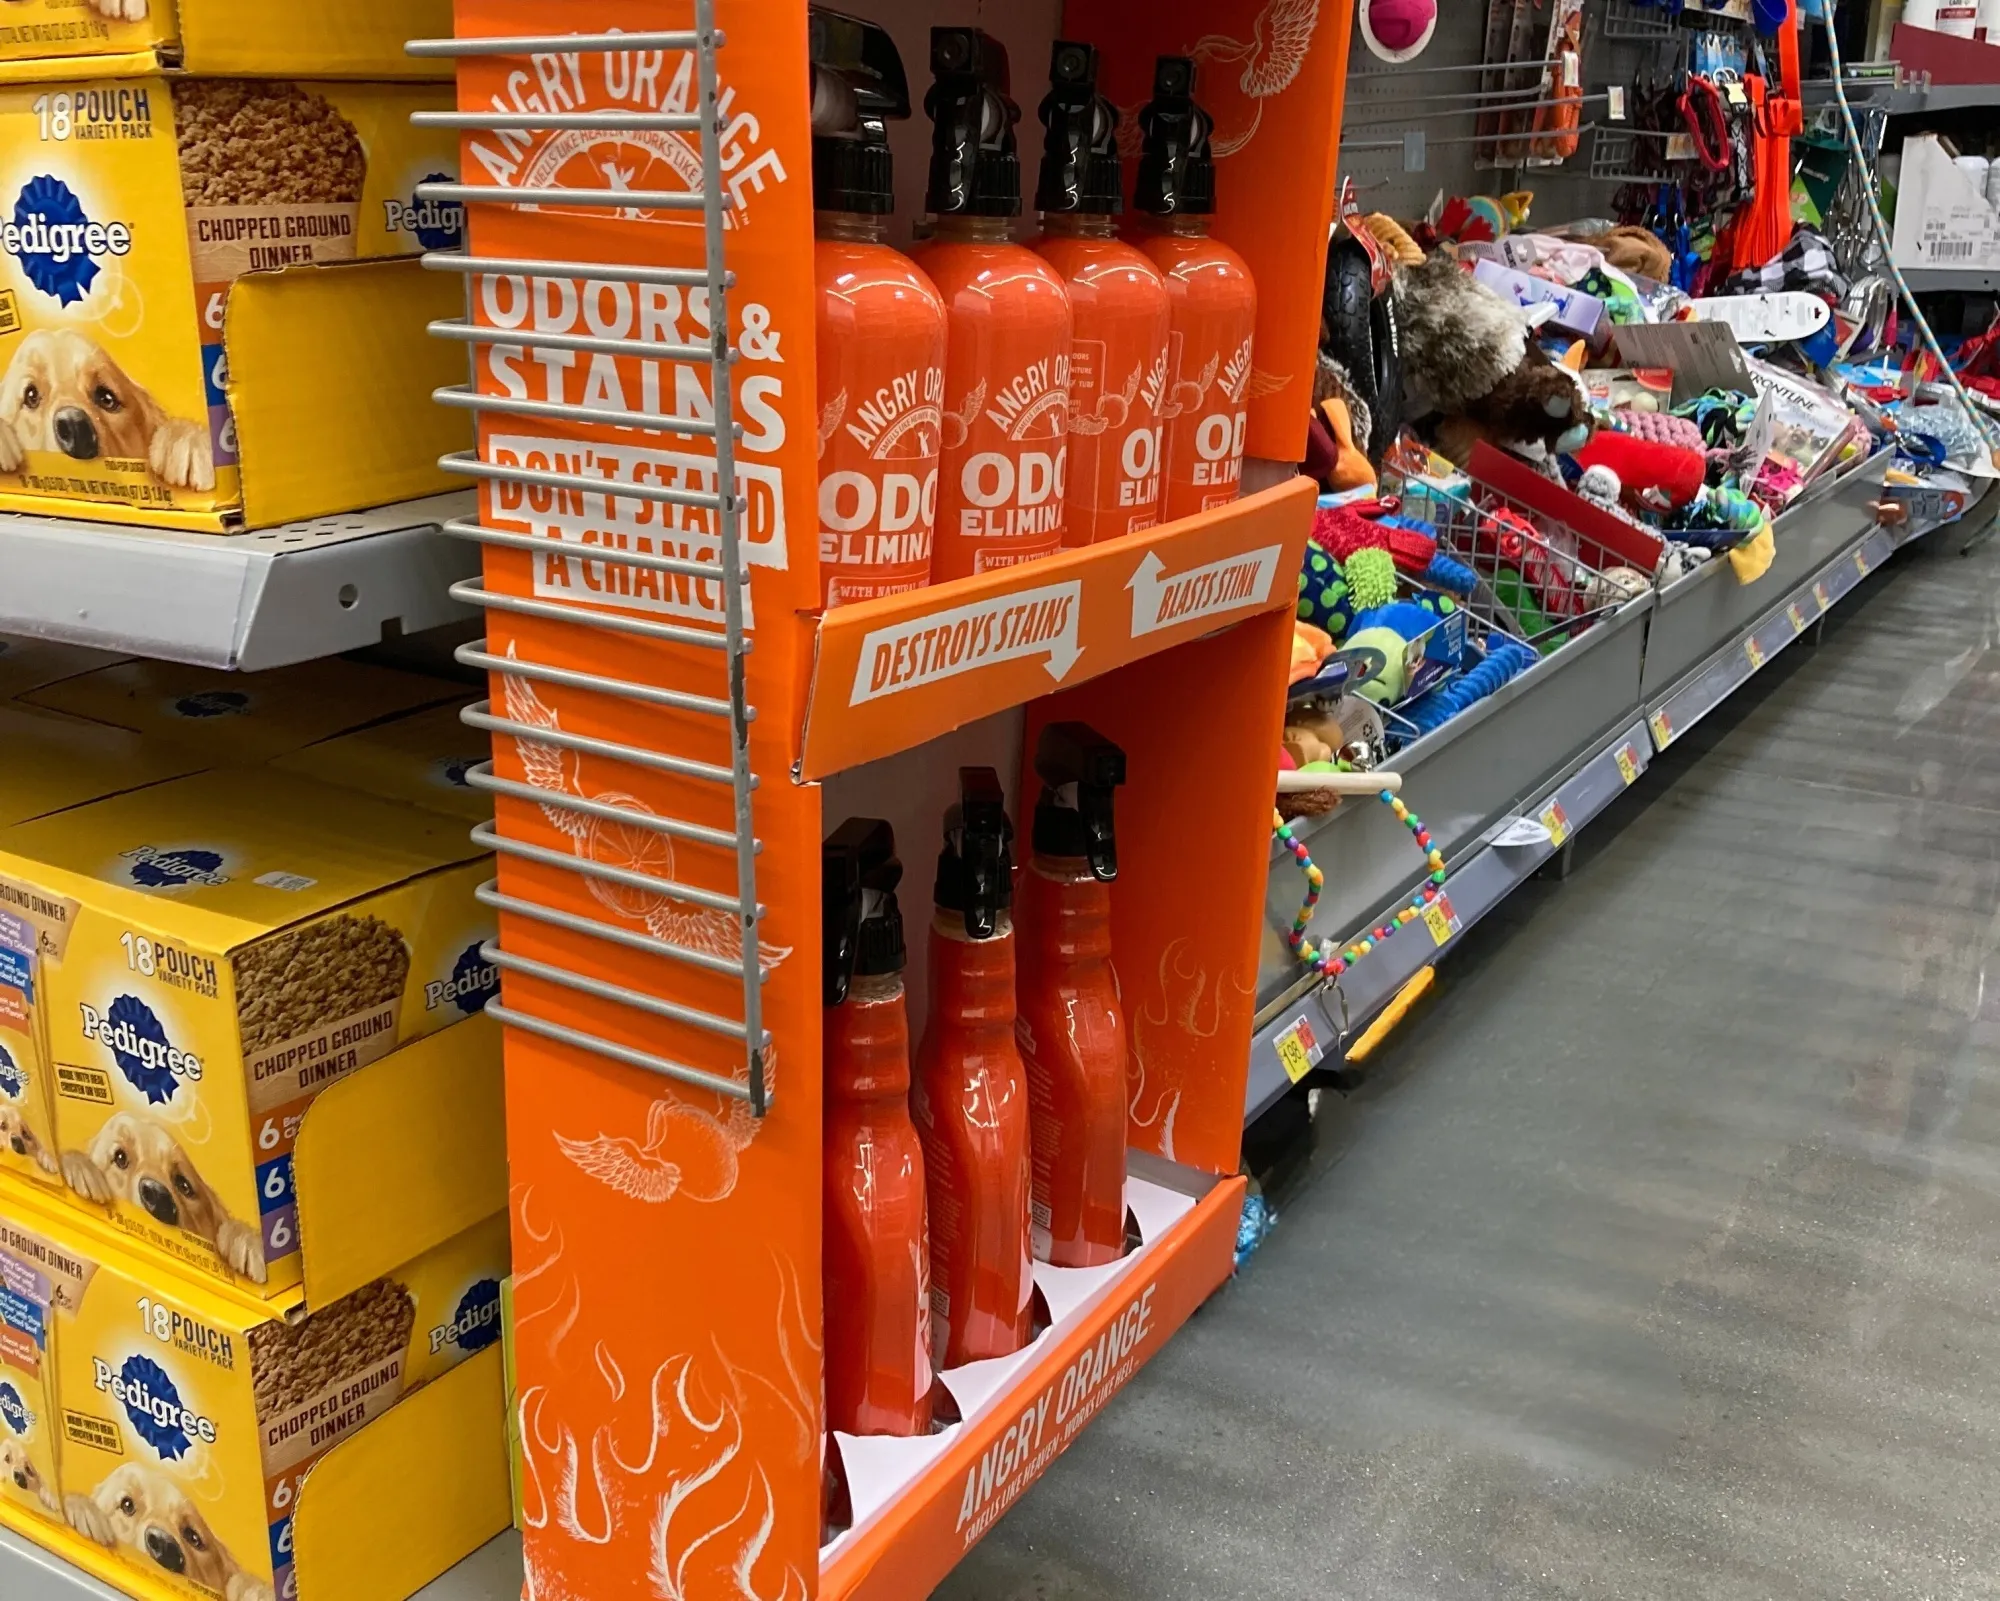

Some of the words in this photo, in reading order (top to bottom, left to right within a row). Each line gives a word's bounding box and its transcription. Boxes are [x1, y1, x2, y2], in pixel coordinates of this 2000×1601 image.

[33, 92, 71, 141] 18
[73, 88, 151, 123] POUCH
[74, 124, 118, 140] VARIETY
[122, 122, 152, 140] PACK
[470, 33, 587, 188] ANGRY
[558, 138, 580, 160] LIKE
[673, 153, 701, 187] LIKE
[198, 216, 281, 241] CHOPPED
[285, 213, 352, 239] GROUND
[204, 293, 223, 329] 6
[739, 303, 785, 363] &
[489, 344, 787, 453] STAINS
[845, 369, 918, 451] ANGRY
[986, 356, 1049, 434] ANGRY
[495, 448, 620, 521] DON'T
[545, 525, 571, 588] A
[985, 556, 1015, 568] WITH
[840, 584, 873, 599] WITH
[1155, 572, 1217, 625] BLASTS
[1214, 559, 1264, 606] STINK
[868, 610, 997, 694] DESTROYS
[993, 594, 1074, 652] STAINS
[118, 844, 231, 887] Pedigree
[32, 895, 66, 923] DINNER
[41, 930, 49, 947] 6
[119, 930, 155, 977] 18
[154, 941, 218, 986] POUCH
[157, 970, 193, 992] VARIETY
[194, 982, 219, 1000] PACK
[80, 1003, 203, 1082] Pedigree
[253, 1034, 329, 1081] CHOPPED
[331, 1009, 393, 1051] GROUND
[298, 1049, 358, 1089] DINNER
[258, 1117, 280, 1150] 6
[264, 1166, 286, 1199] 6
[9, 1231, 46, 1263] GROUND
[48, 1249, 83, 1281] DINNER
[270, 1216, 292, 1249] 6
[55, 1284, 63, 1300] 6
[136, 1297, 171, 1343] 18
[171, 1310, 233, 1359] POUCH
[173, 1335, 208, 1362] VARIETY
[210, 1351, 234, 1372] PACK
[92, 1355, 217, 1443] Pedigree
[268, 1394, 338, 1447] CHOPPED
[341, 1360, 399, 1406] GROUND
[310, 1401, 366, 1447] DINNER
[955, 1385, 1054, 1534] ANGRY
[1055, 1282, 1157, 1426] ORANGE
[963, 1496, 1002, 1551] SMELLS
[1000, 1478, 1024, 1510] LIKE
[1022, 1440, 1060, 1484] HEAVEN
[1063, 1401, 1097, 1442] WORKS
[1095, 1378, 1116, 1407] LIKE
[1113, 1355, 1135, 1386] HELL
[272, 1477, 292, 1509] 6
